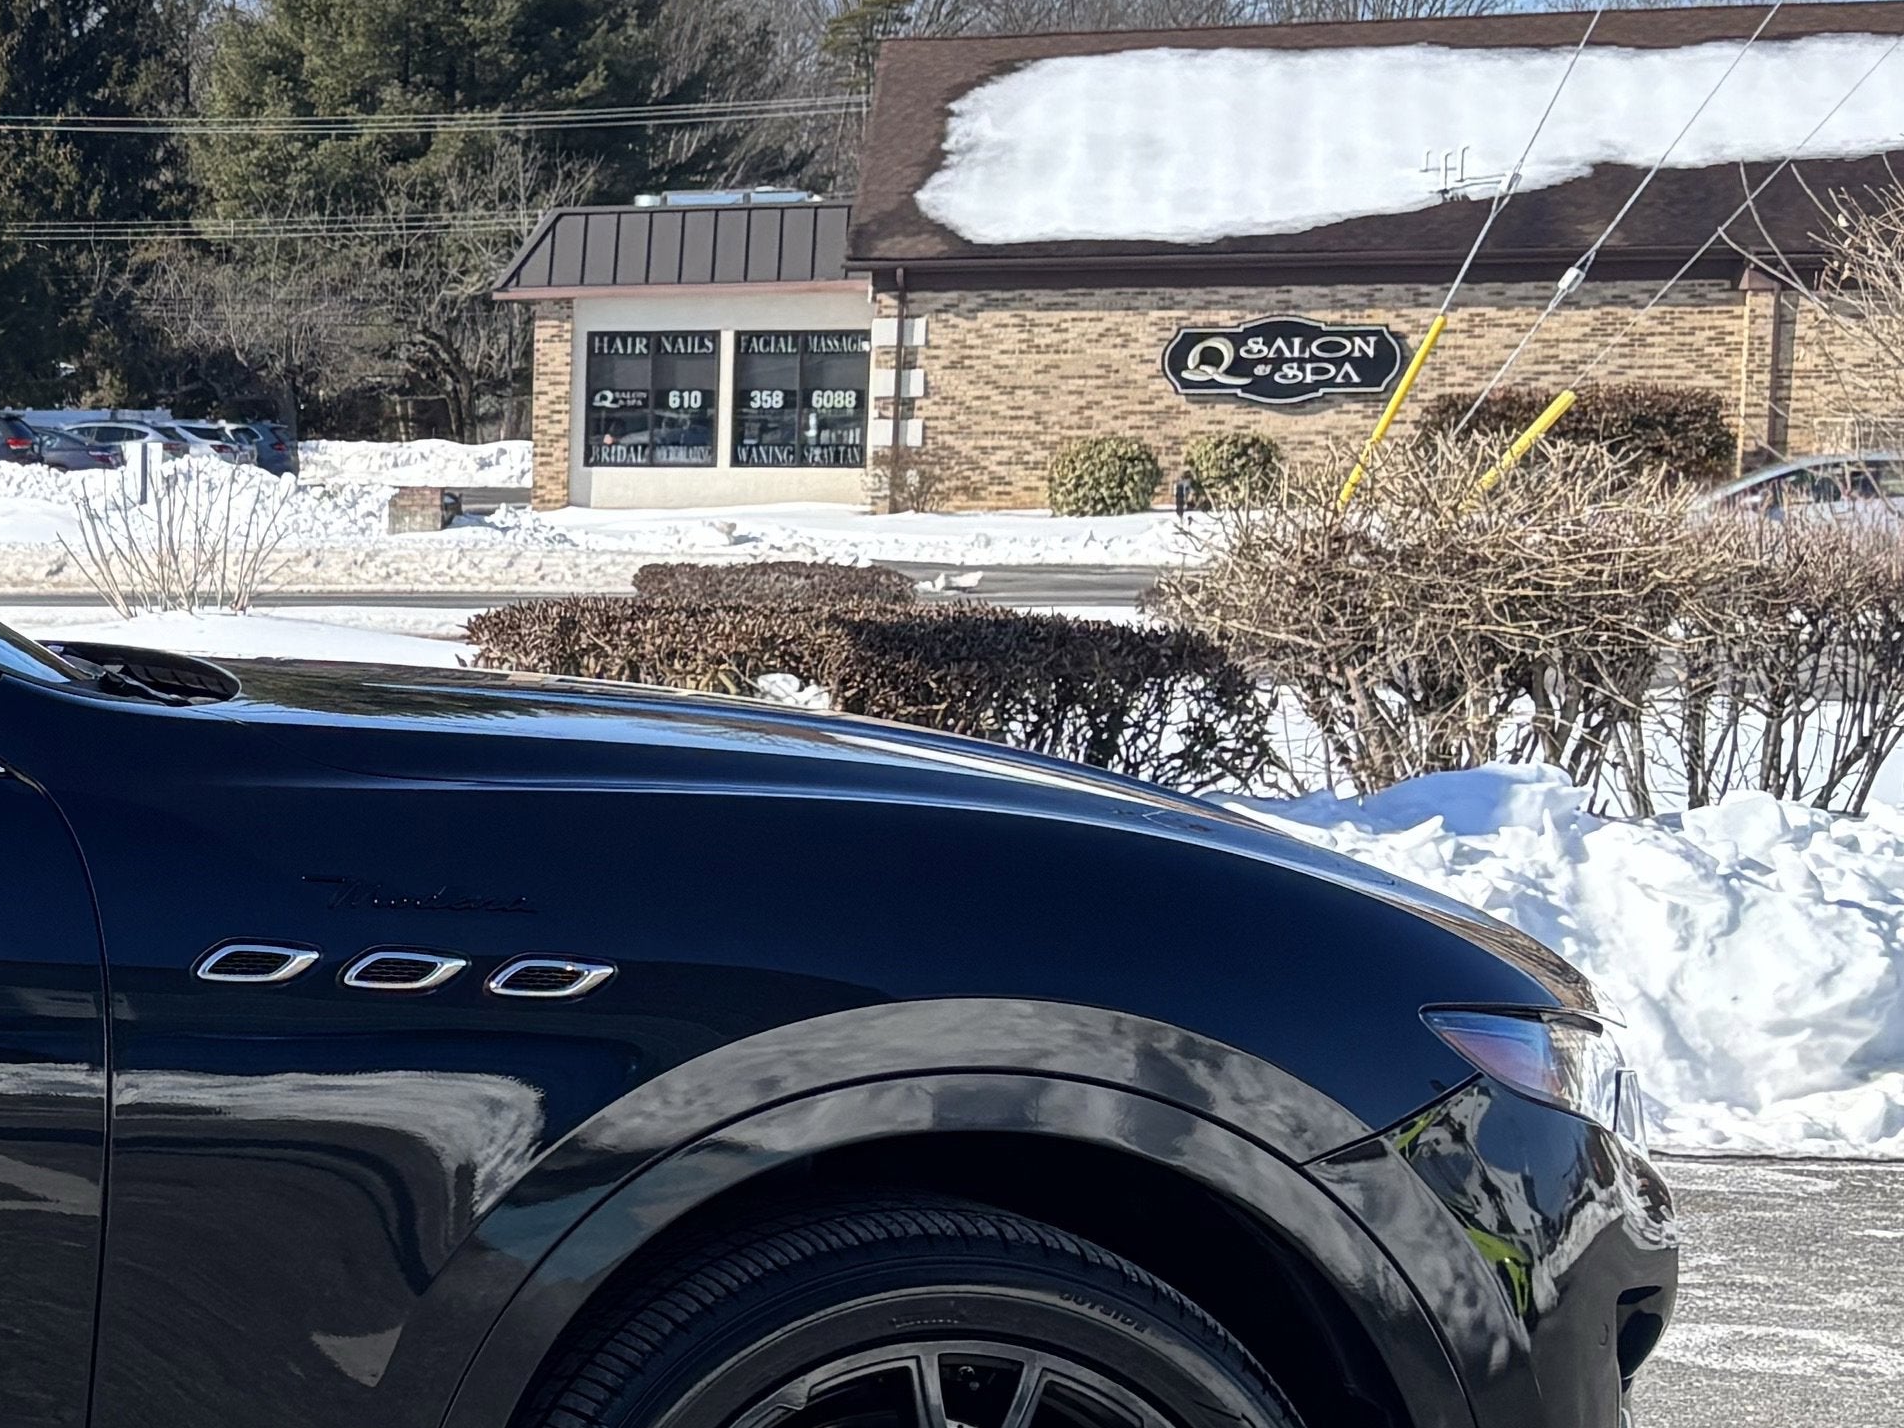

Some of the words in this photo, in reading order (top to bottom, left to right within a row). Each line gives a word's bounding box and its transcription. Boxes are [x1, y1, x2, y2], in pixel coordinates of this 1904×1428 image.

[594, 336, 648, 354] HAIR
[660, 336, 713, 354] NAILS
[740, 335, 797, 353] FACIAL
[1181, 337, 1252, 385] Q
[1239, 336, 1378, 359] SALON
[1273, 363, 1361, 384] SPA
[668, 390, 702, 408] 610
[750, 390, 784, 409] 358
[811, 390, 857, 409] 6088
[589, 445, 646, 464] BRIDAL
[737, 445, 794, 464] WAXING
